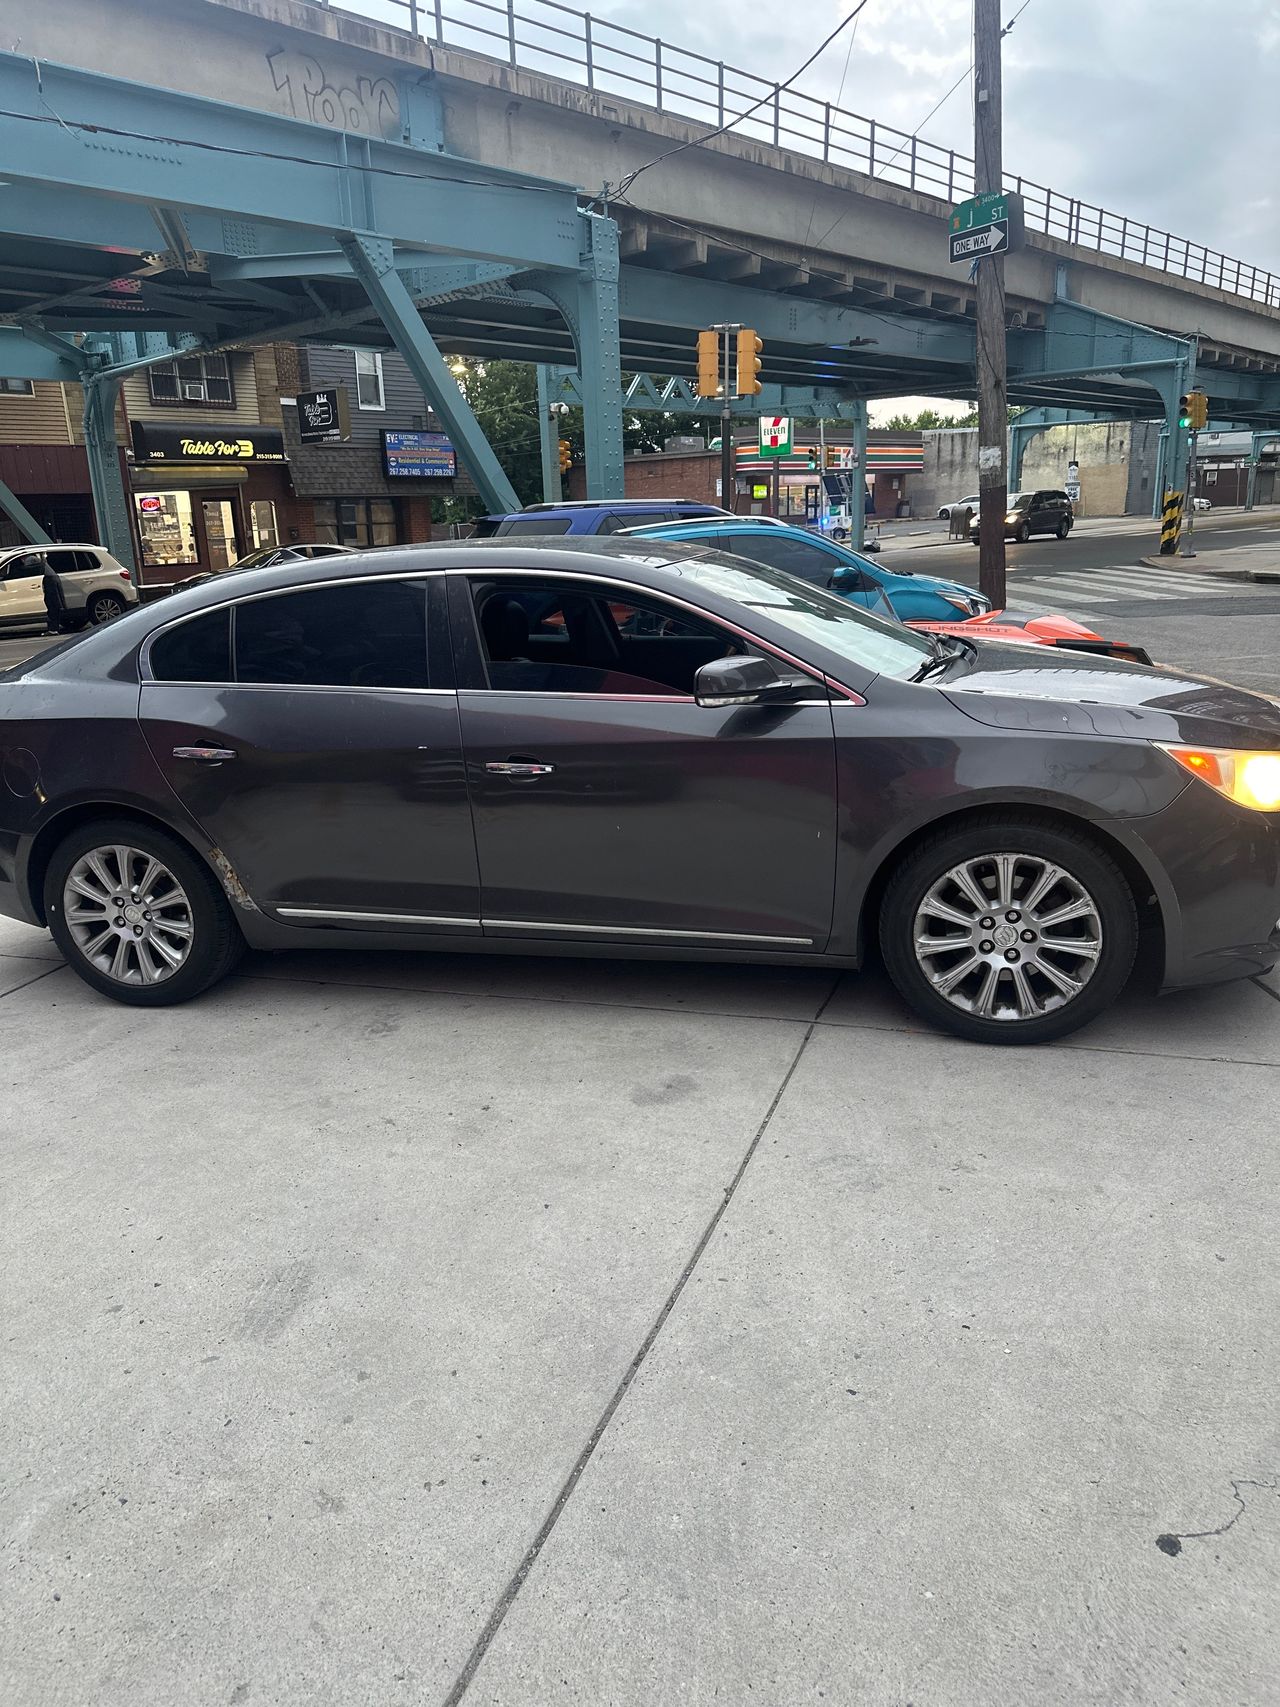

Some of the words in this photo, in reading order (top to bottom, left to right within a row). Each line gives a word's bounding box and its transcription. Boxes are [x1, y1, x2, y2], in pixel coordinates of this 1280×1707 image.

[967, 208, 973, 228] J
[991, 206, 1003, 220] ST
[955, 239, 971, 254] ONE
[973, 233, 990, 248] WAY
[386, 434, 398, 443] EVE
[180, 439, 215, 456] Table
[214, 440, 239, 456] For
[236, 440, 254, 457] 3
[150, 451, 165, 459] 3403
[915, 625, 1011, 633] SLINGSHOT
